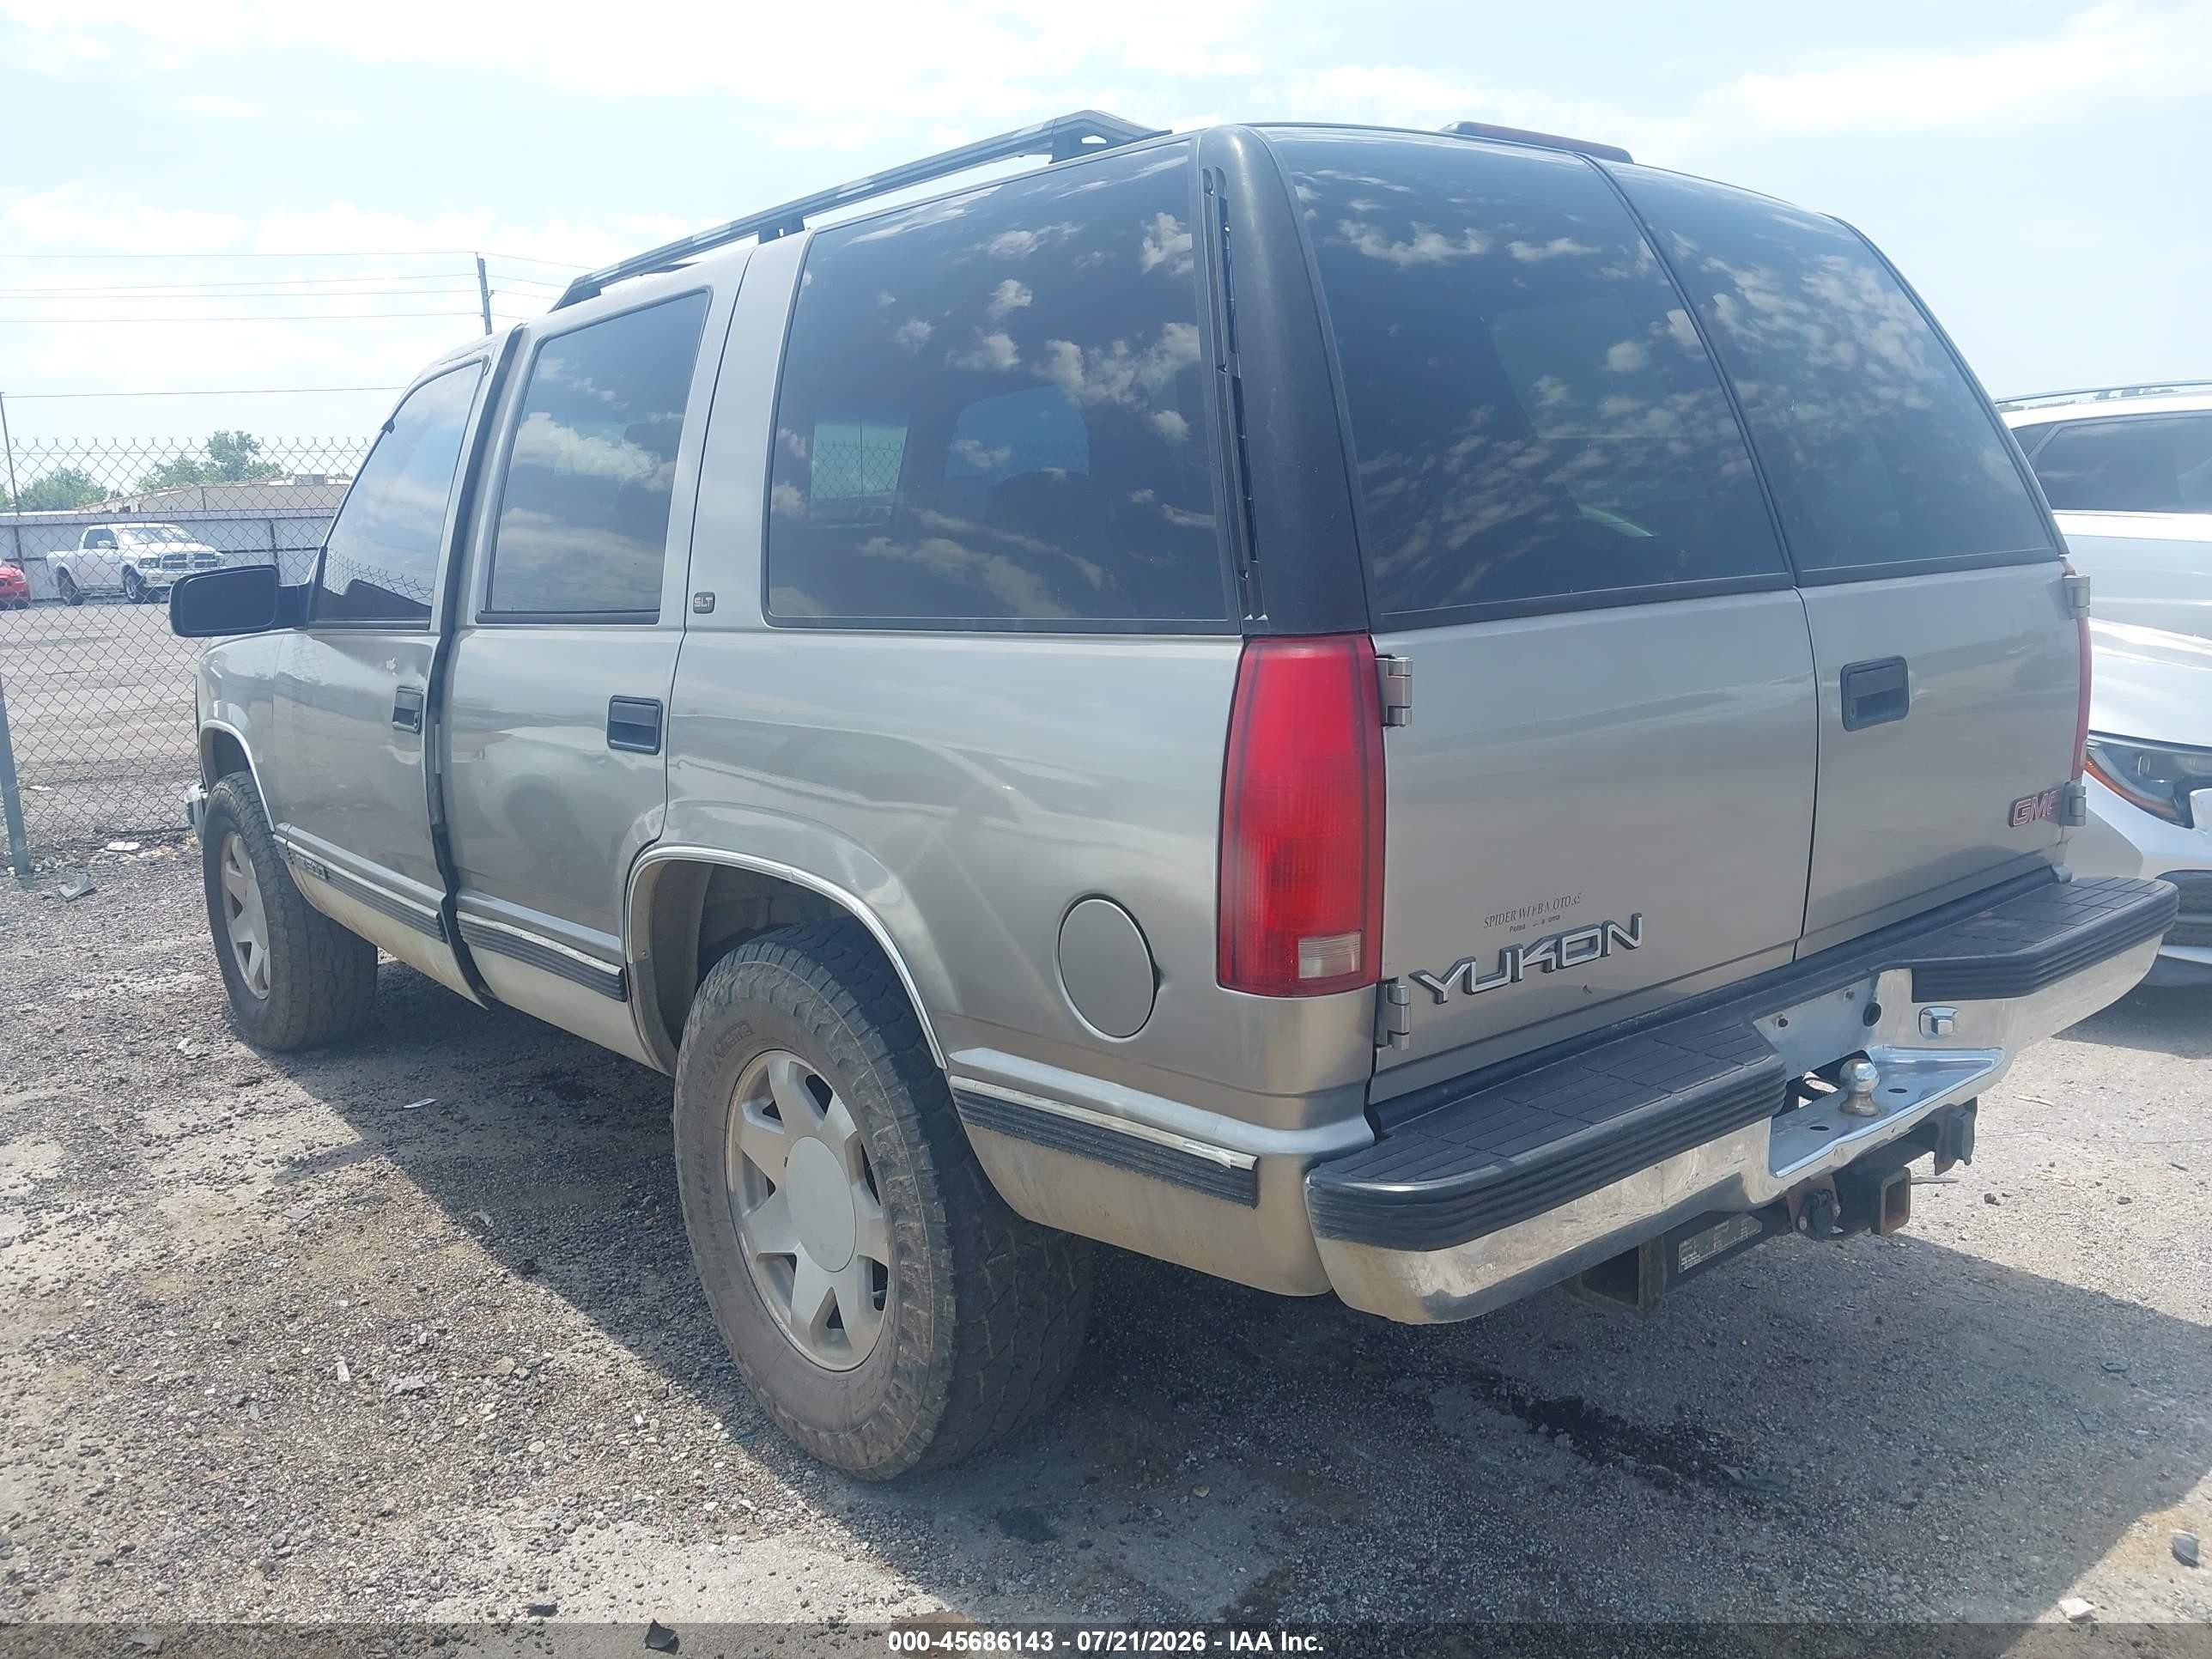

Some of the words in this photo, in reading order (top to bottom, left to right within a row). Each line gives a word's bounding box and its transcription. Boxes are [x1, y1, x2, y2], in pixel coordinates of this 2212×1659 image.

[1484, 910, 1516, 928] SPIDER
[1545, 892, 1582, 912] OTOS
[1408, 913, 1642, 1005] YUKON
